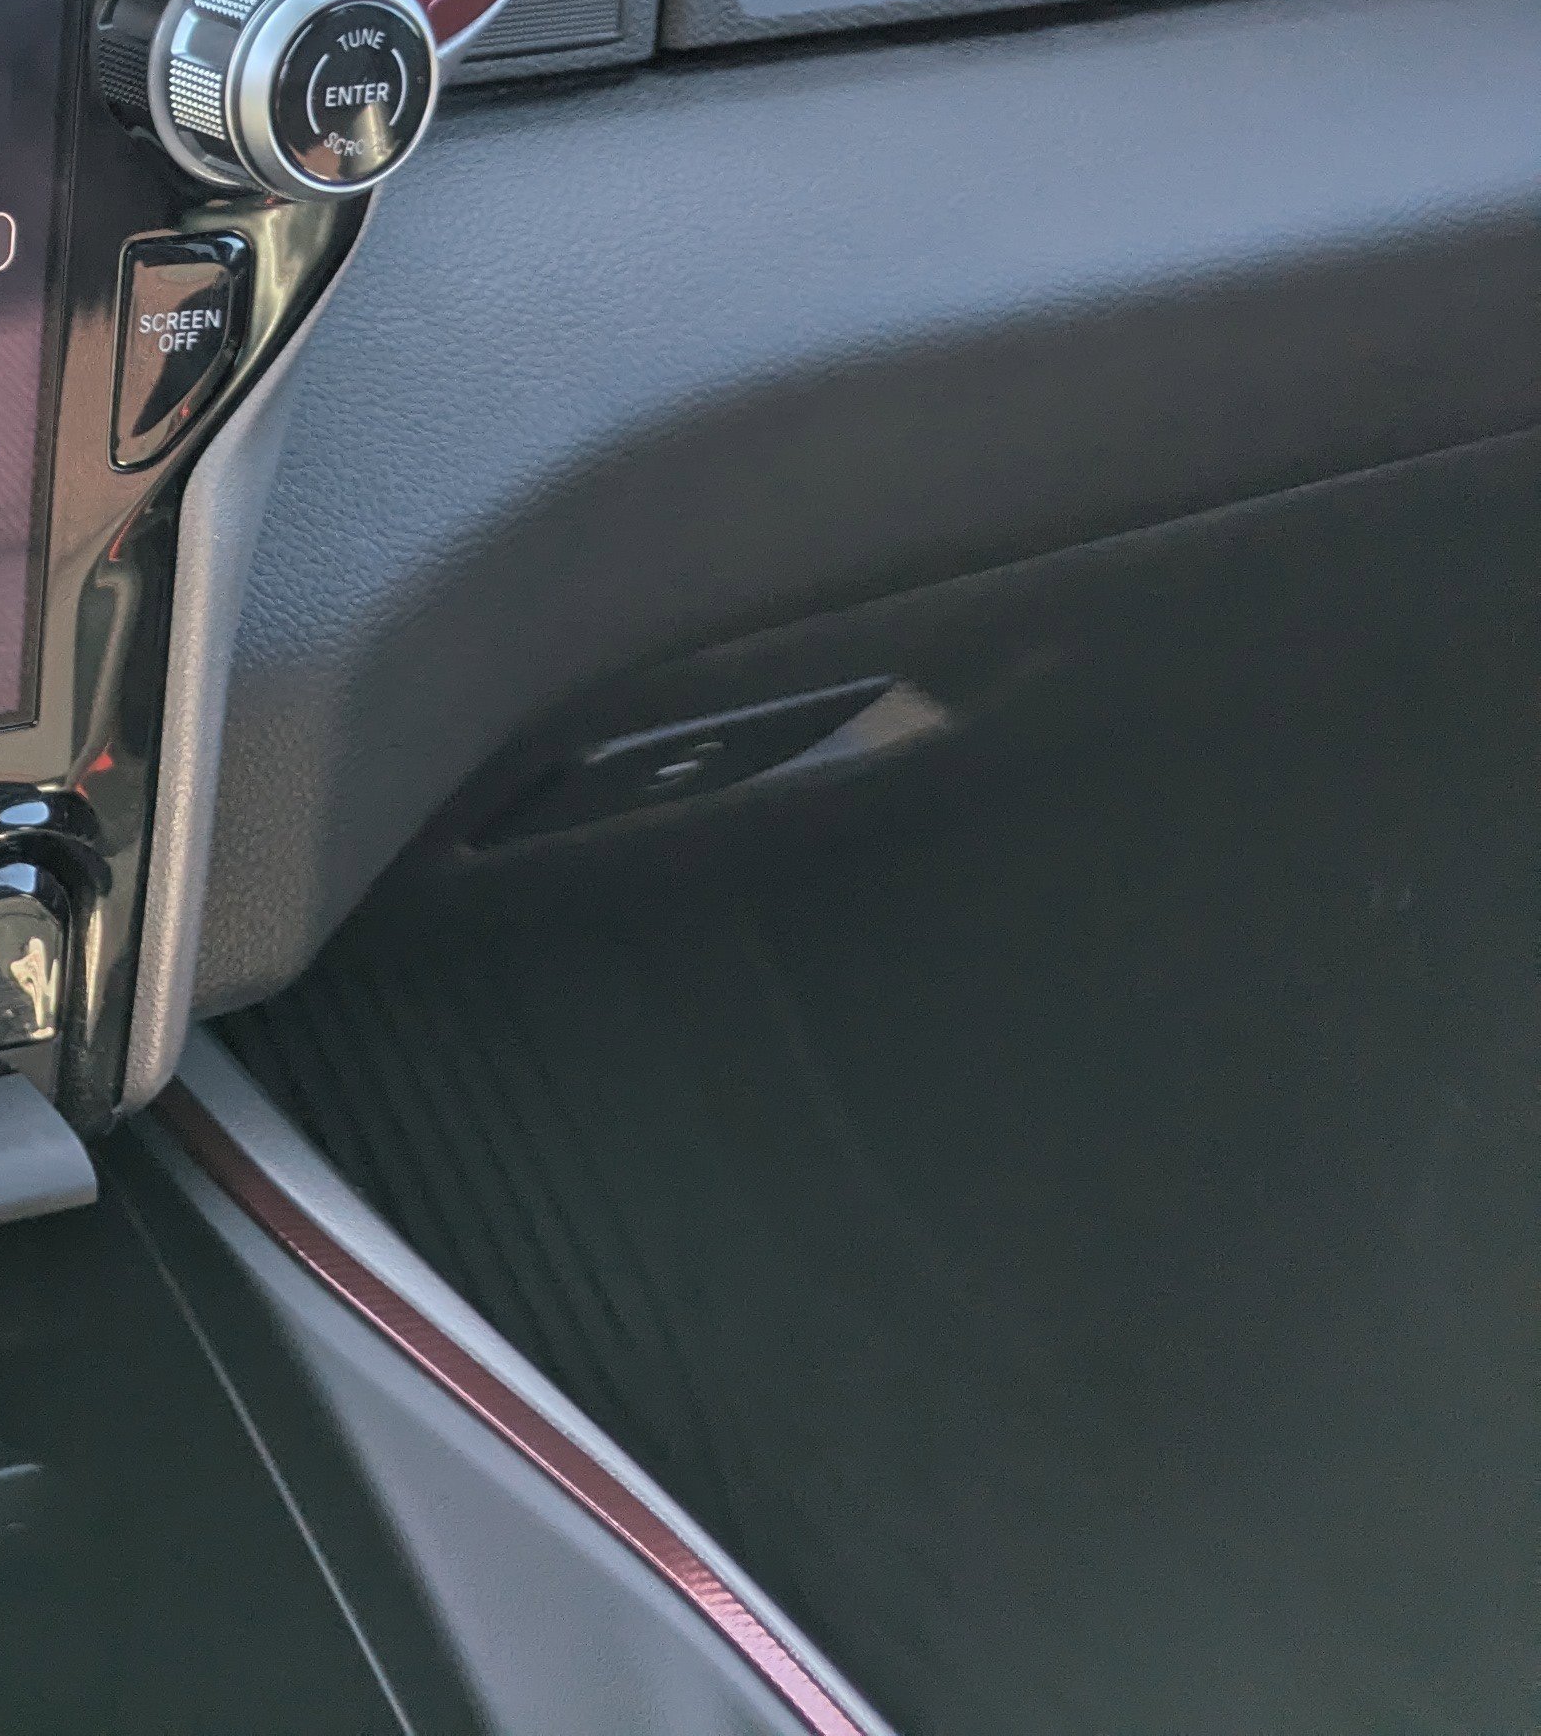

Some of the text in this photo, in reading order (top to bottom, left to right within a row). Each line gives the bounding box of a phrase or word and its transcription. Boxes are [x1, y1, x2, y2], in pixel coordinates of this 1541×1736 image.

[336, 27, 386, 52] TUNE
[325, 81, 390, 107] ENTER
[323, 130, 390, 157] SCRO
[139, 309, 221, 335] SCREEN
[158, 331, 201, 353] OFF
